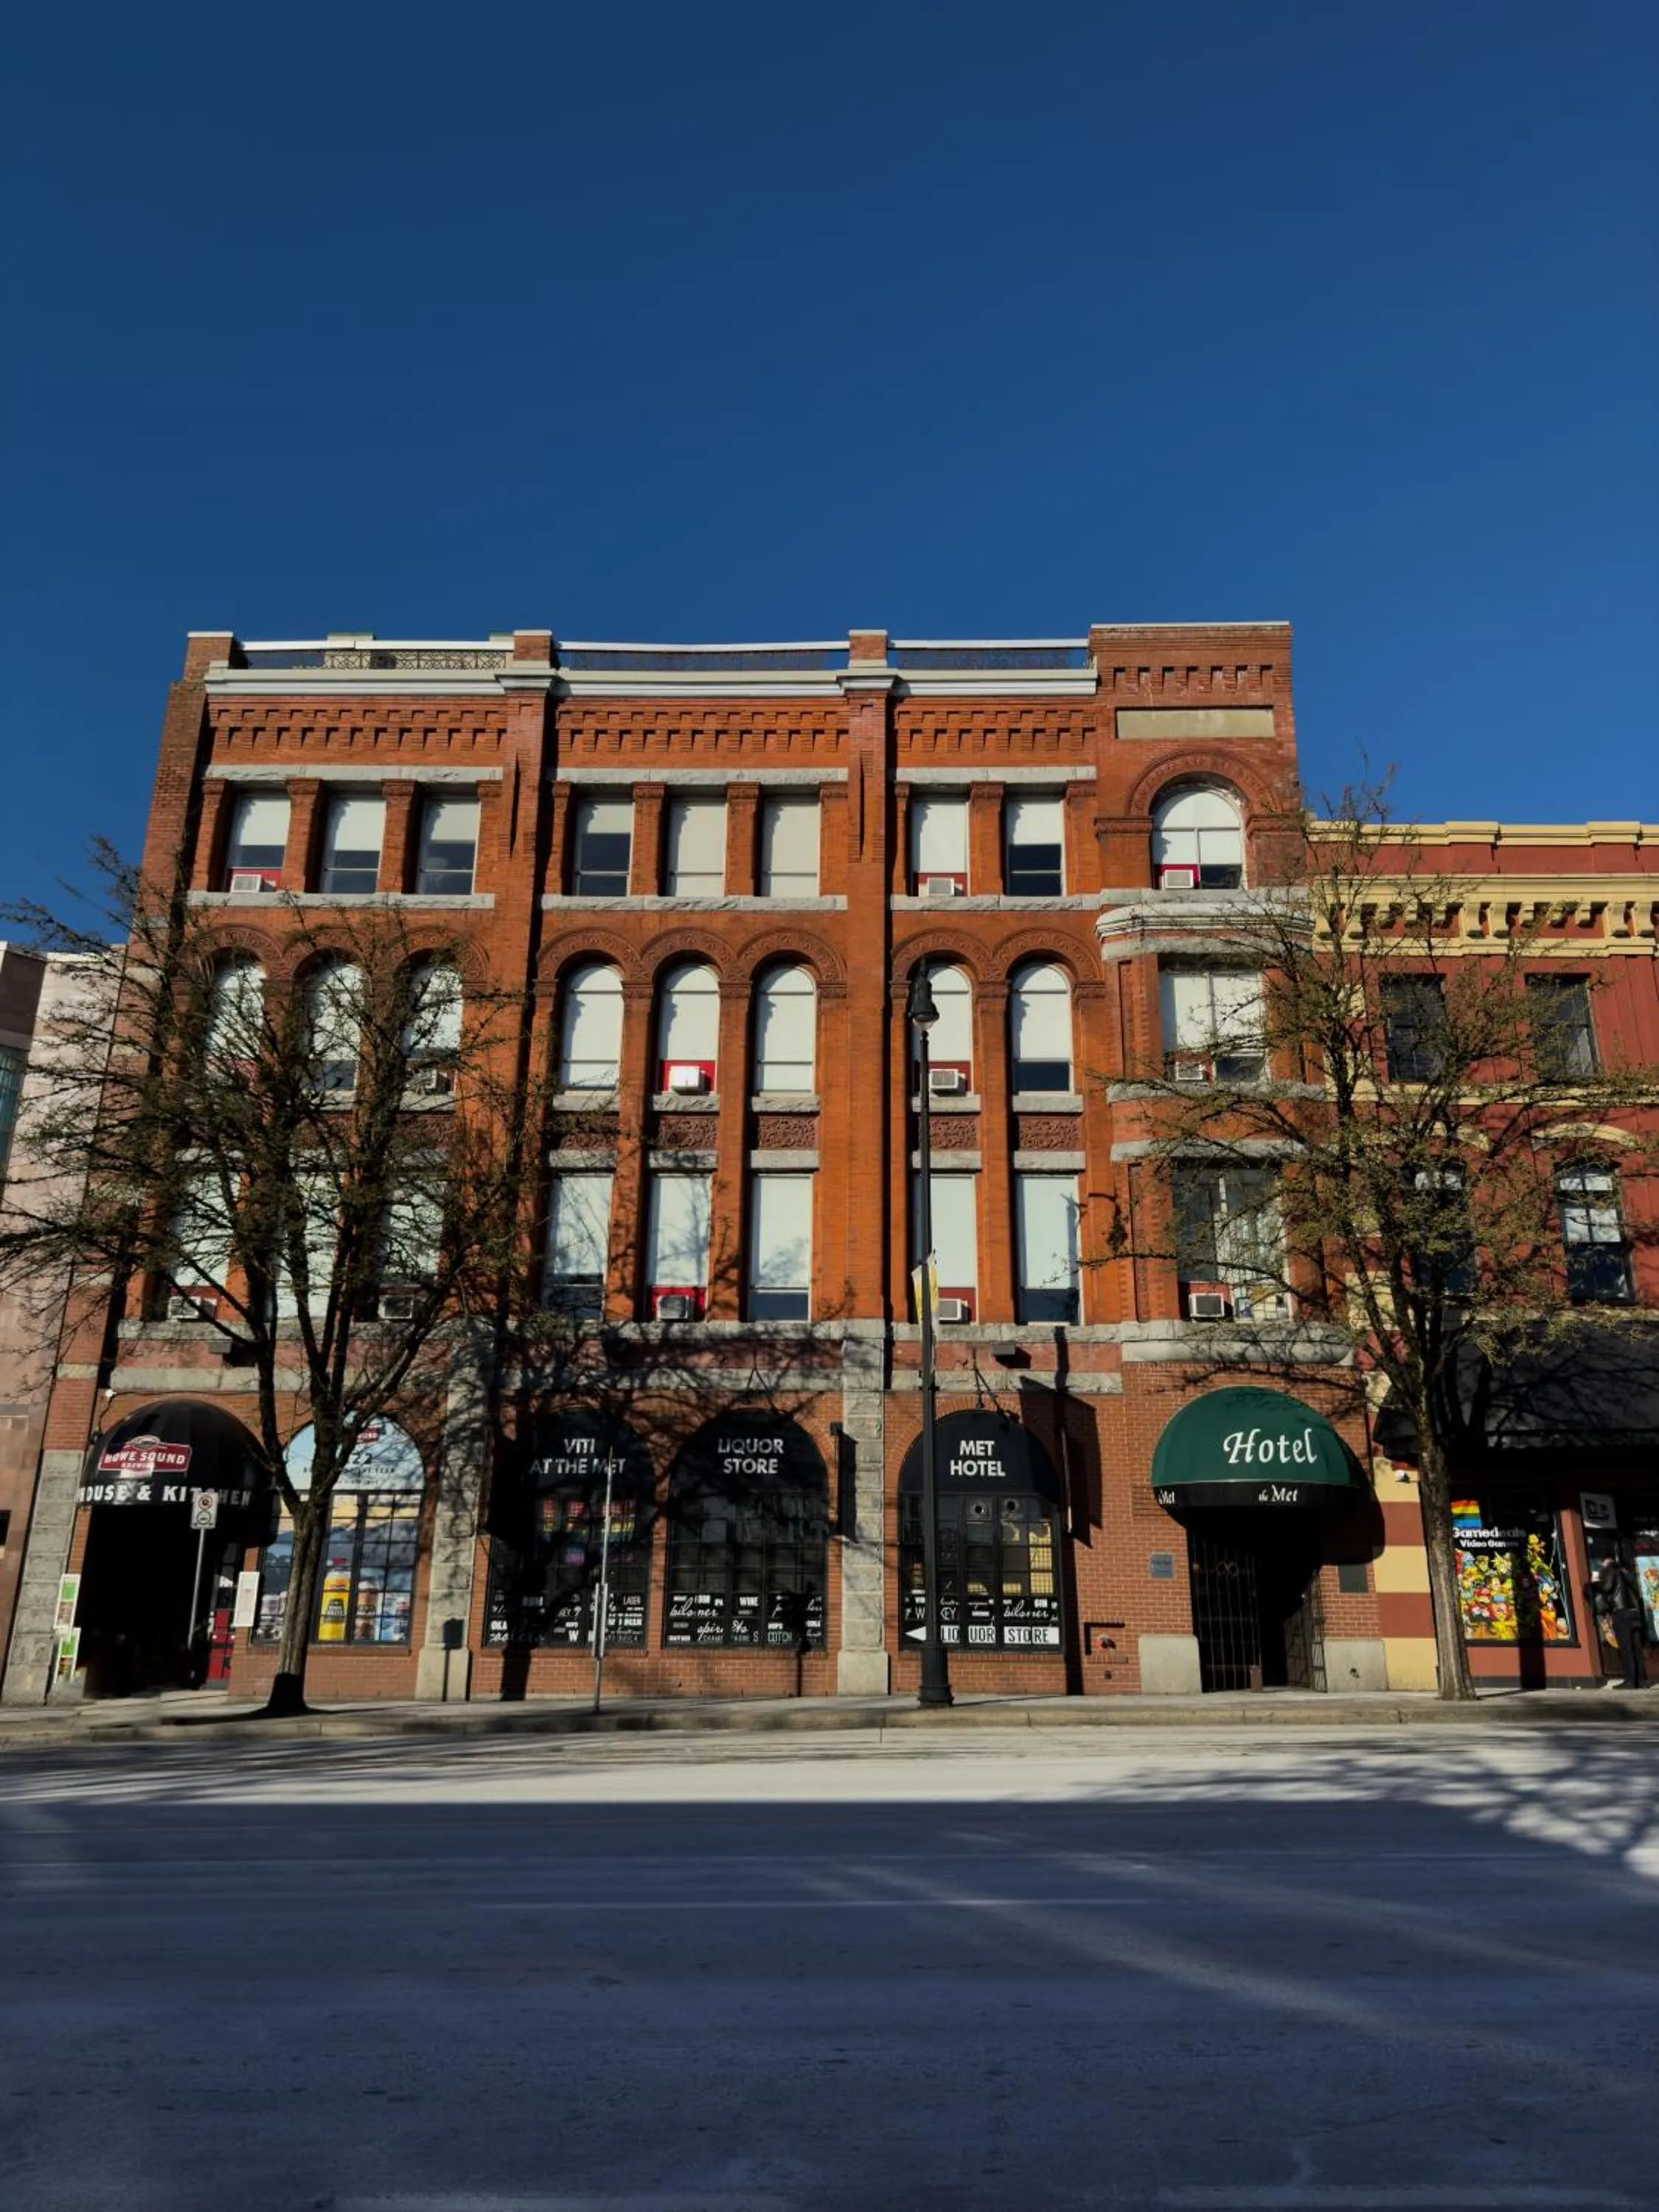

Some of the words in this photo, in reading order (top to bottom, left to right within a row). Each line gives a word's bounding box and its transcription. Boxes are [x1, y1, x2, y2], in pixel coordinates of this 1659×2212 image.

[563, 1439, 596, 1454] VITI
[717, 1439, 785, 1455] LIQUOR
[959, 1439, 995, 1456] MET
[1222, 1427, 1318, 1464] Hotel
[103, 1450, 137, 1464] HOWE
[140, 1452, 187, 1465] SOUND
[723, 1457, 779, 1475] STORE
[529, 1458, 553, 1475] AT
[554, 1458, 588, 1475] THE
[591, 1458, 626, 1475] MET
[949, 1459, 1007, 1477] HOTEL
[137, 1484, 152, 1501] &
[161, 1486, 253, 1506] KITHEN
[1270, 1484, 1298, 1503] Met
[1459, 1539, 1486, 1548] Video
[1008, 1627, 1050, 1643] STORE
